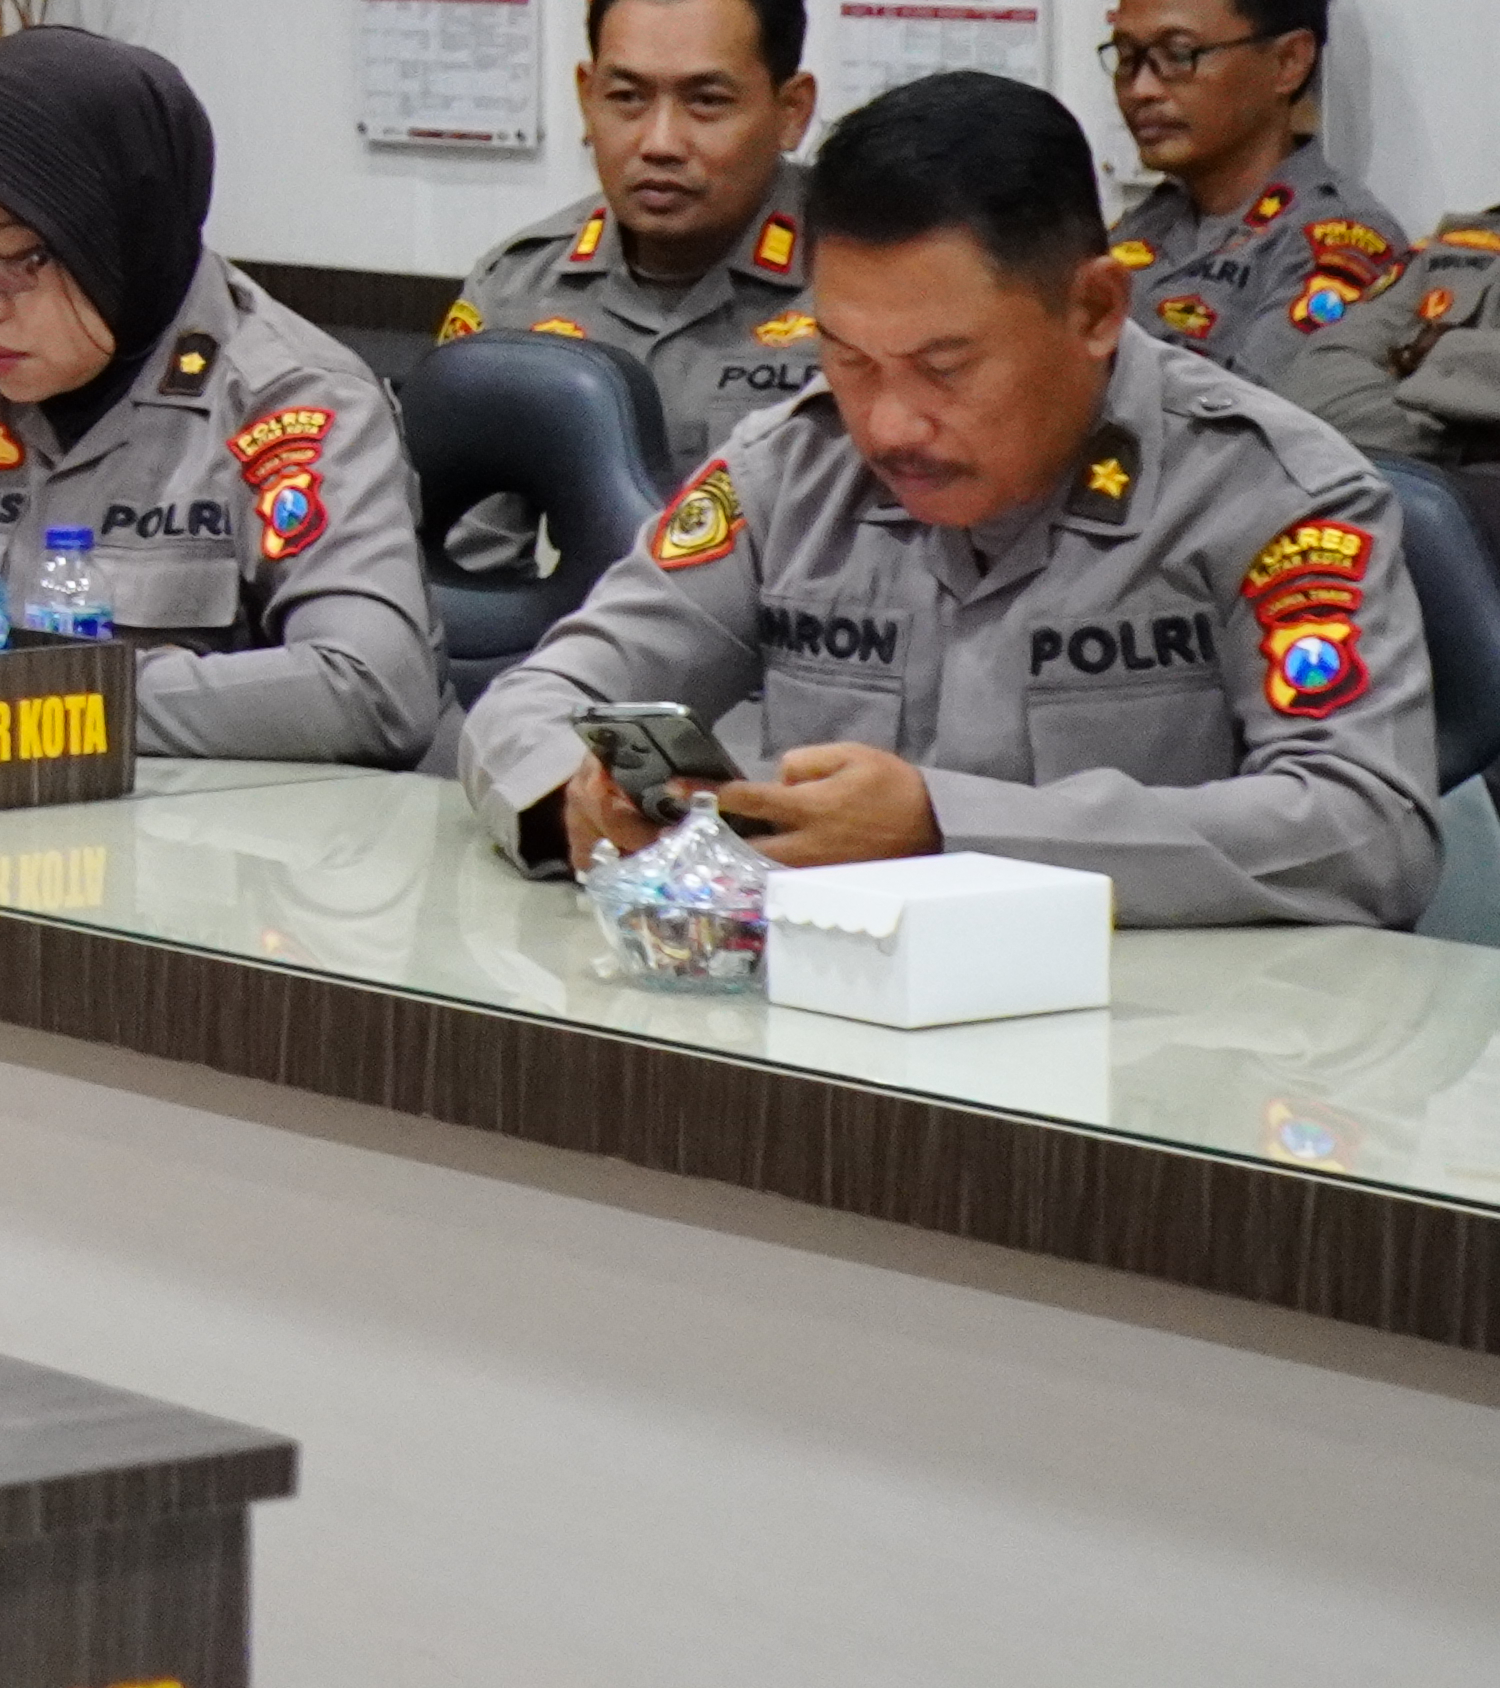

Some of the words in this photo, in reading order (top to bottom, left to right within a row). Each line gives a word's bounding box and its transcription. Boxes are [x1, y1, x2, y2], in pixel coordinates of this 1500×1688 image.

[236, 409, 327, 457] POLRES
[101, 499, 233, 540] POLRI
[1030, 608, 1215, 680] POLRI
[18, 692, 109, 761] KOTA
